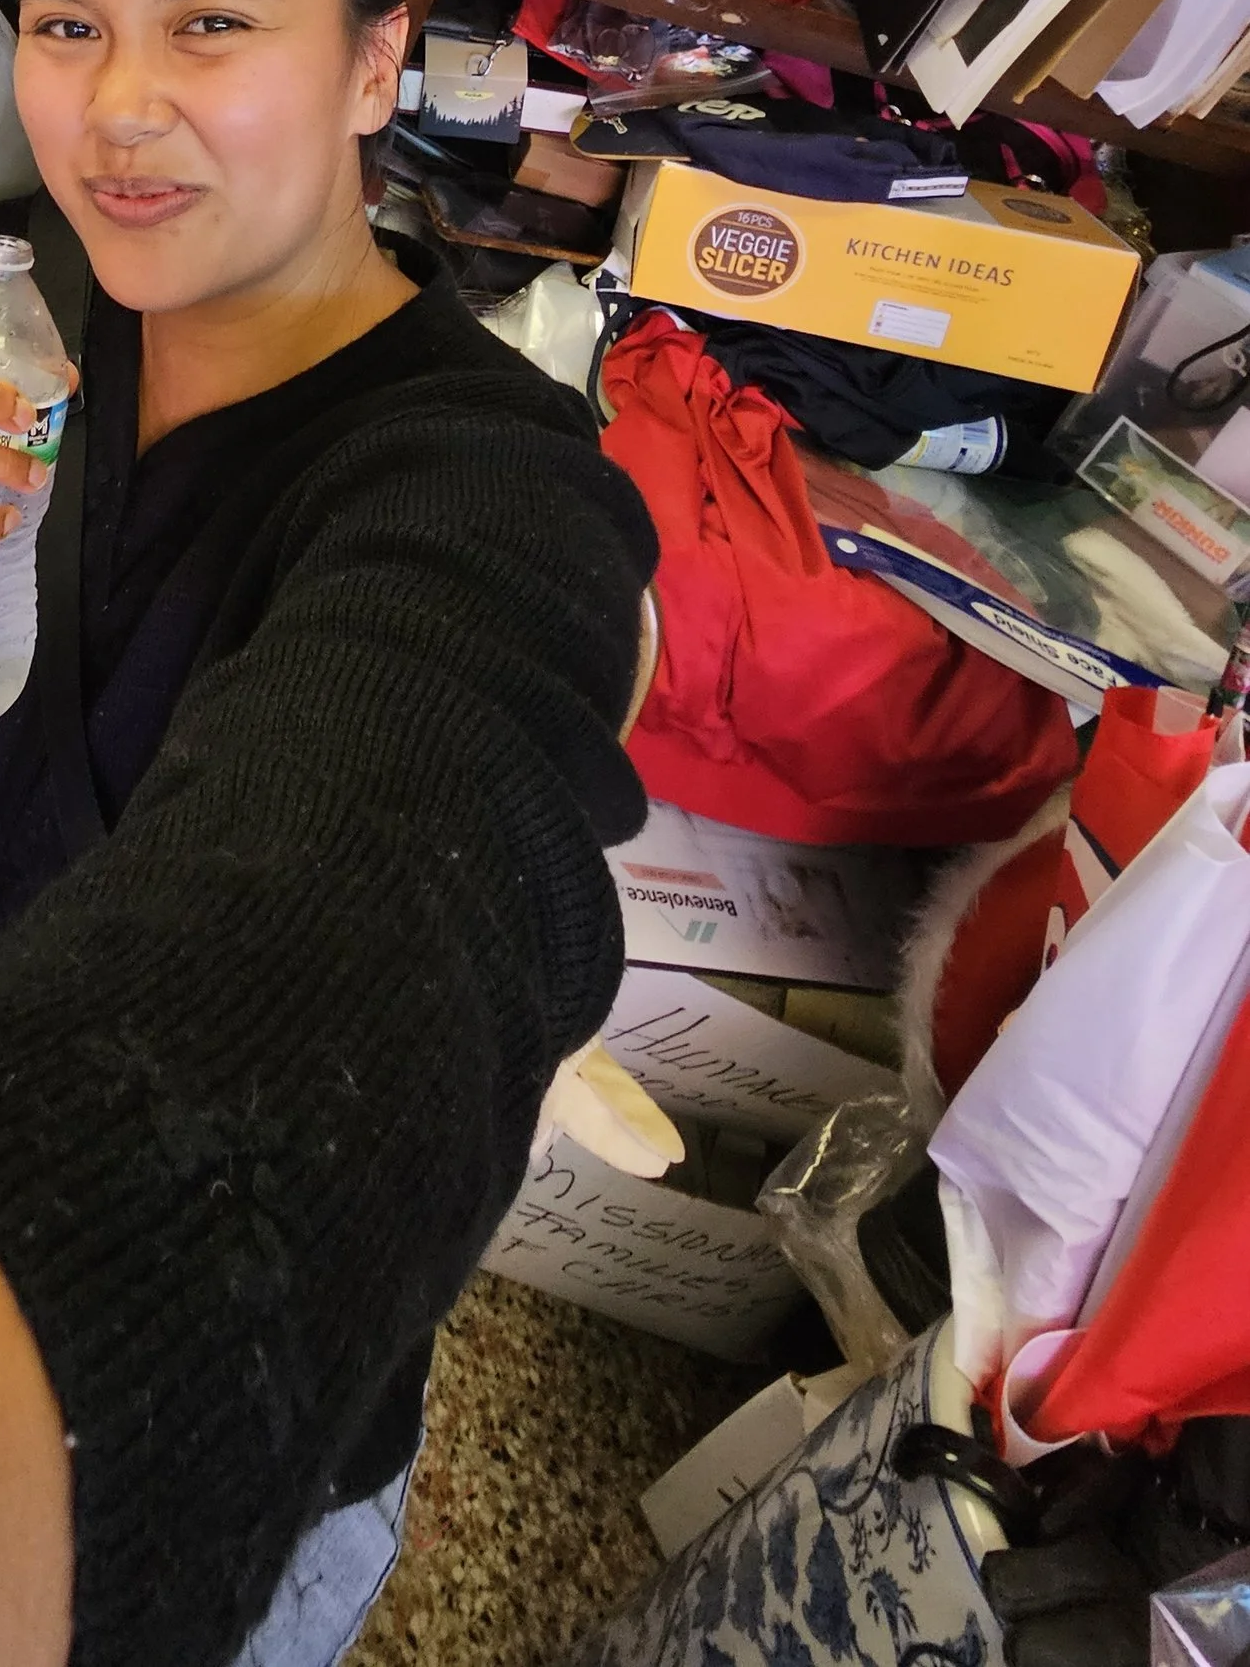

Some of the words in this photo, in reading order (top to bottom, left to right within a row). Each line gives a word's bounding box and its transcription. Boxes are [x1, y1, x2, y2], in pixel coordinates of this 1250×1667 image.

[698, 246, 787, 284] SLICER
[710, 225, 794, 263] VEGGIE
[846, 237, 942, 270] KITCHEN
[947, 257, 1015, 287] IDEAS
[993, 612, 1060, 660] Shield
